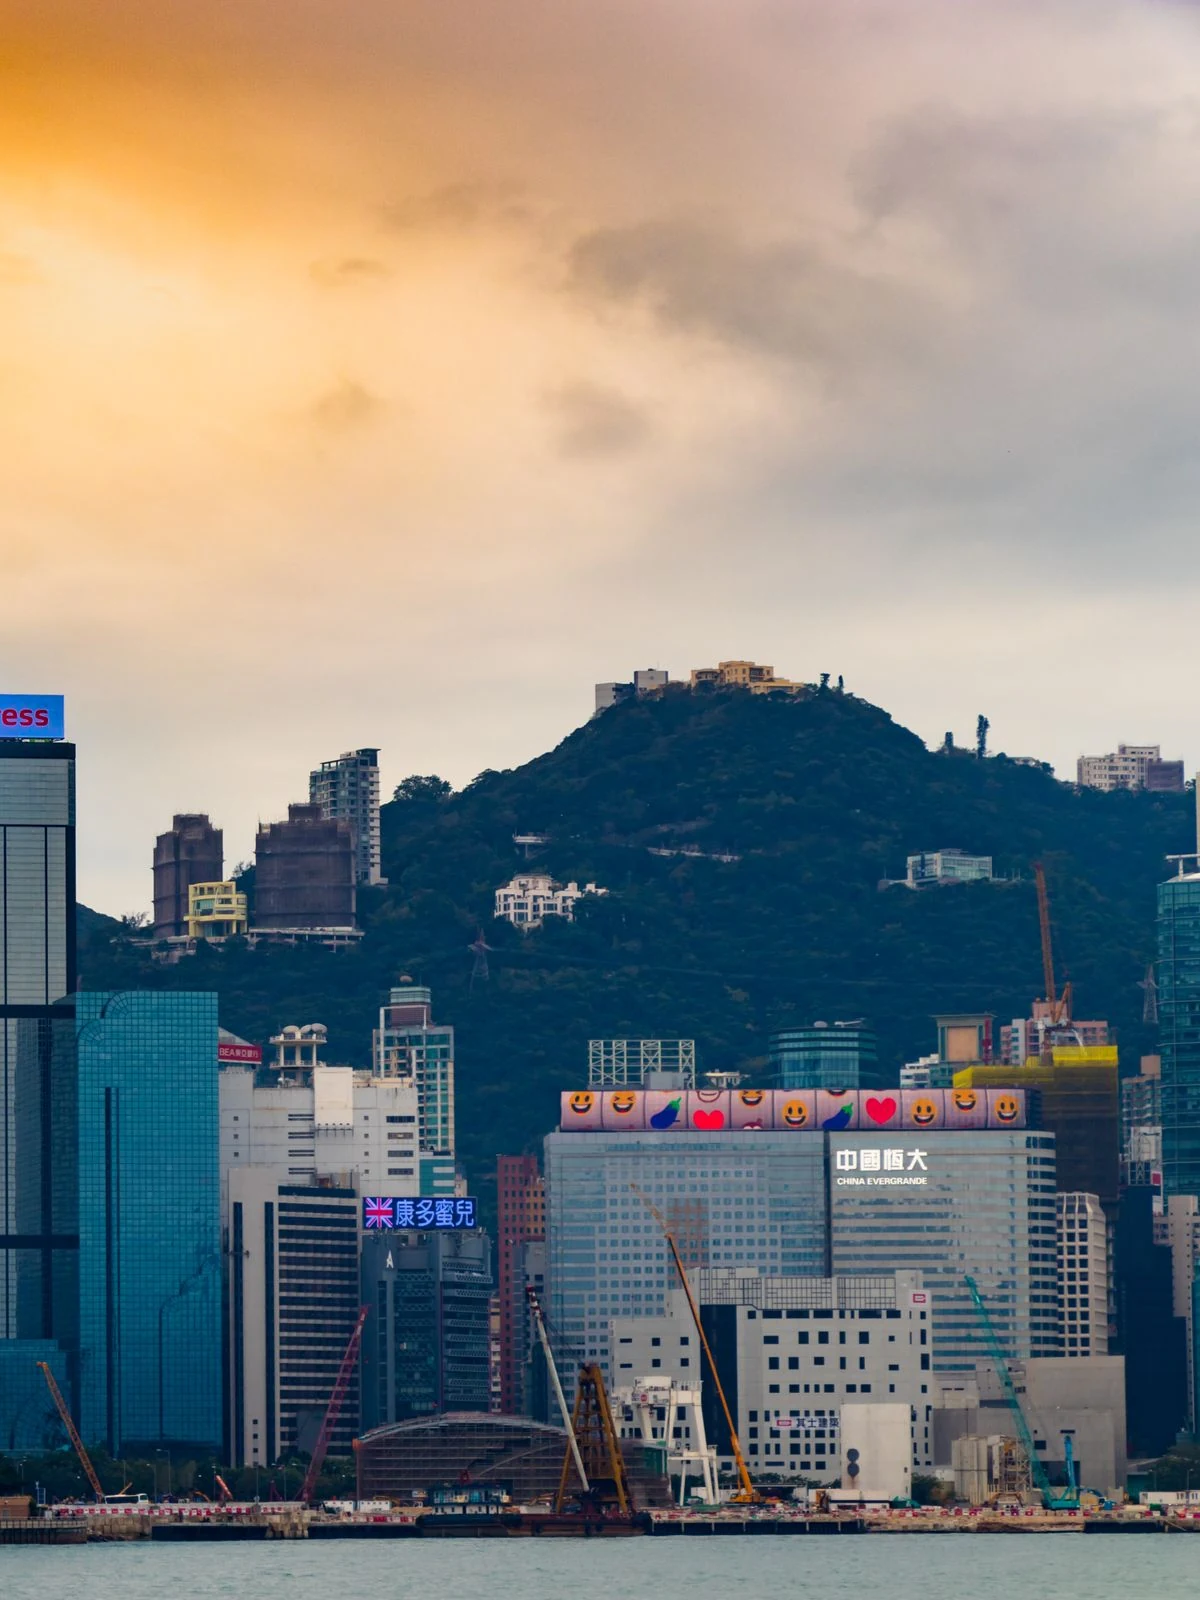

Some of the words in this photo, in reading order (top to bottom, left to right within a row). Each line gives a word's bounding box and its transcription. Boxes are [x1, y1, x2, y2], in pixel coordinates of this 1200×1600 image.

[837, 1177, 865, 1186] CHINA
[867, 1177, 928, 1186] EVERGRANDE
[395, 1199, 475, 1228] 康多蜜兒
